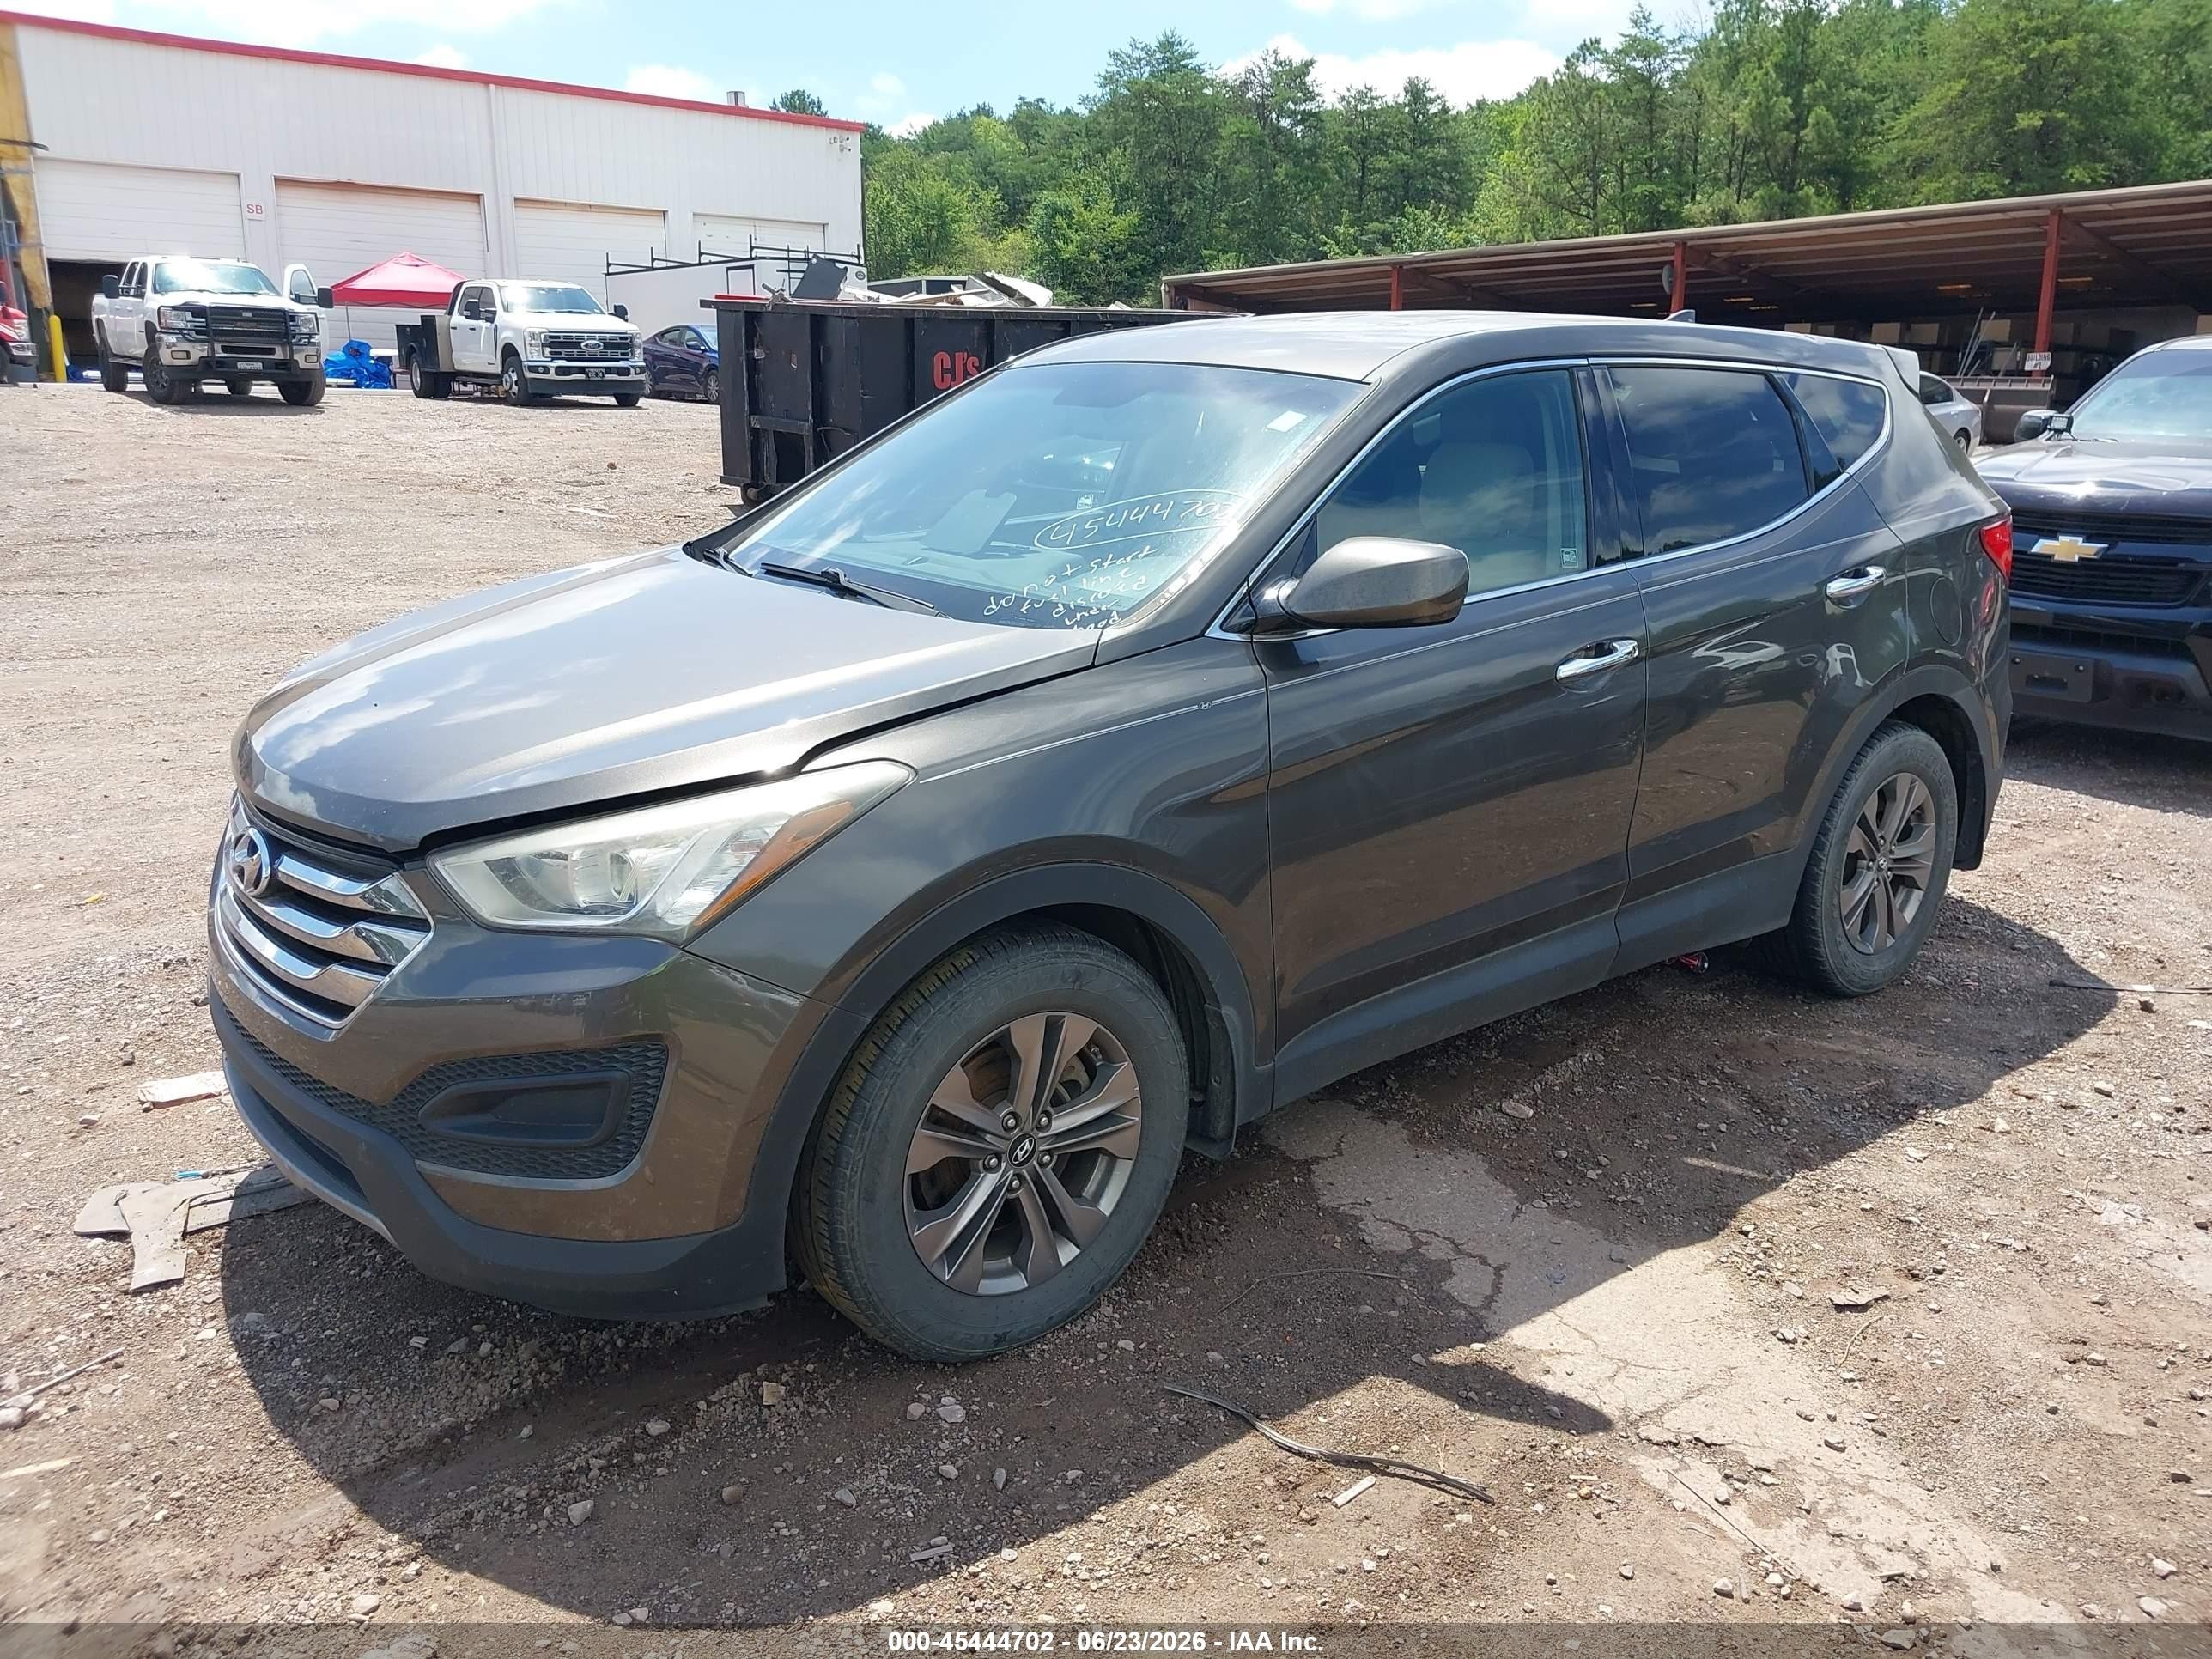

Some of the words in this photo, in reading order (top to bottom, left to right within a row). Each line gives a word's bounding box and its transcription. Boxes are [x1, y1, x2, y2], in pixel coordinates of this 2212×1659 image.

[246, 204, 263, 215] SB
[1049, 500, 1237, 545] 45444702
[983, 592, 1017, 617] do
[1023, 563, 1083, 598] not
